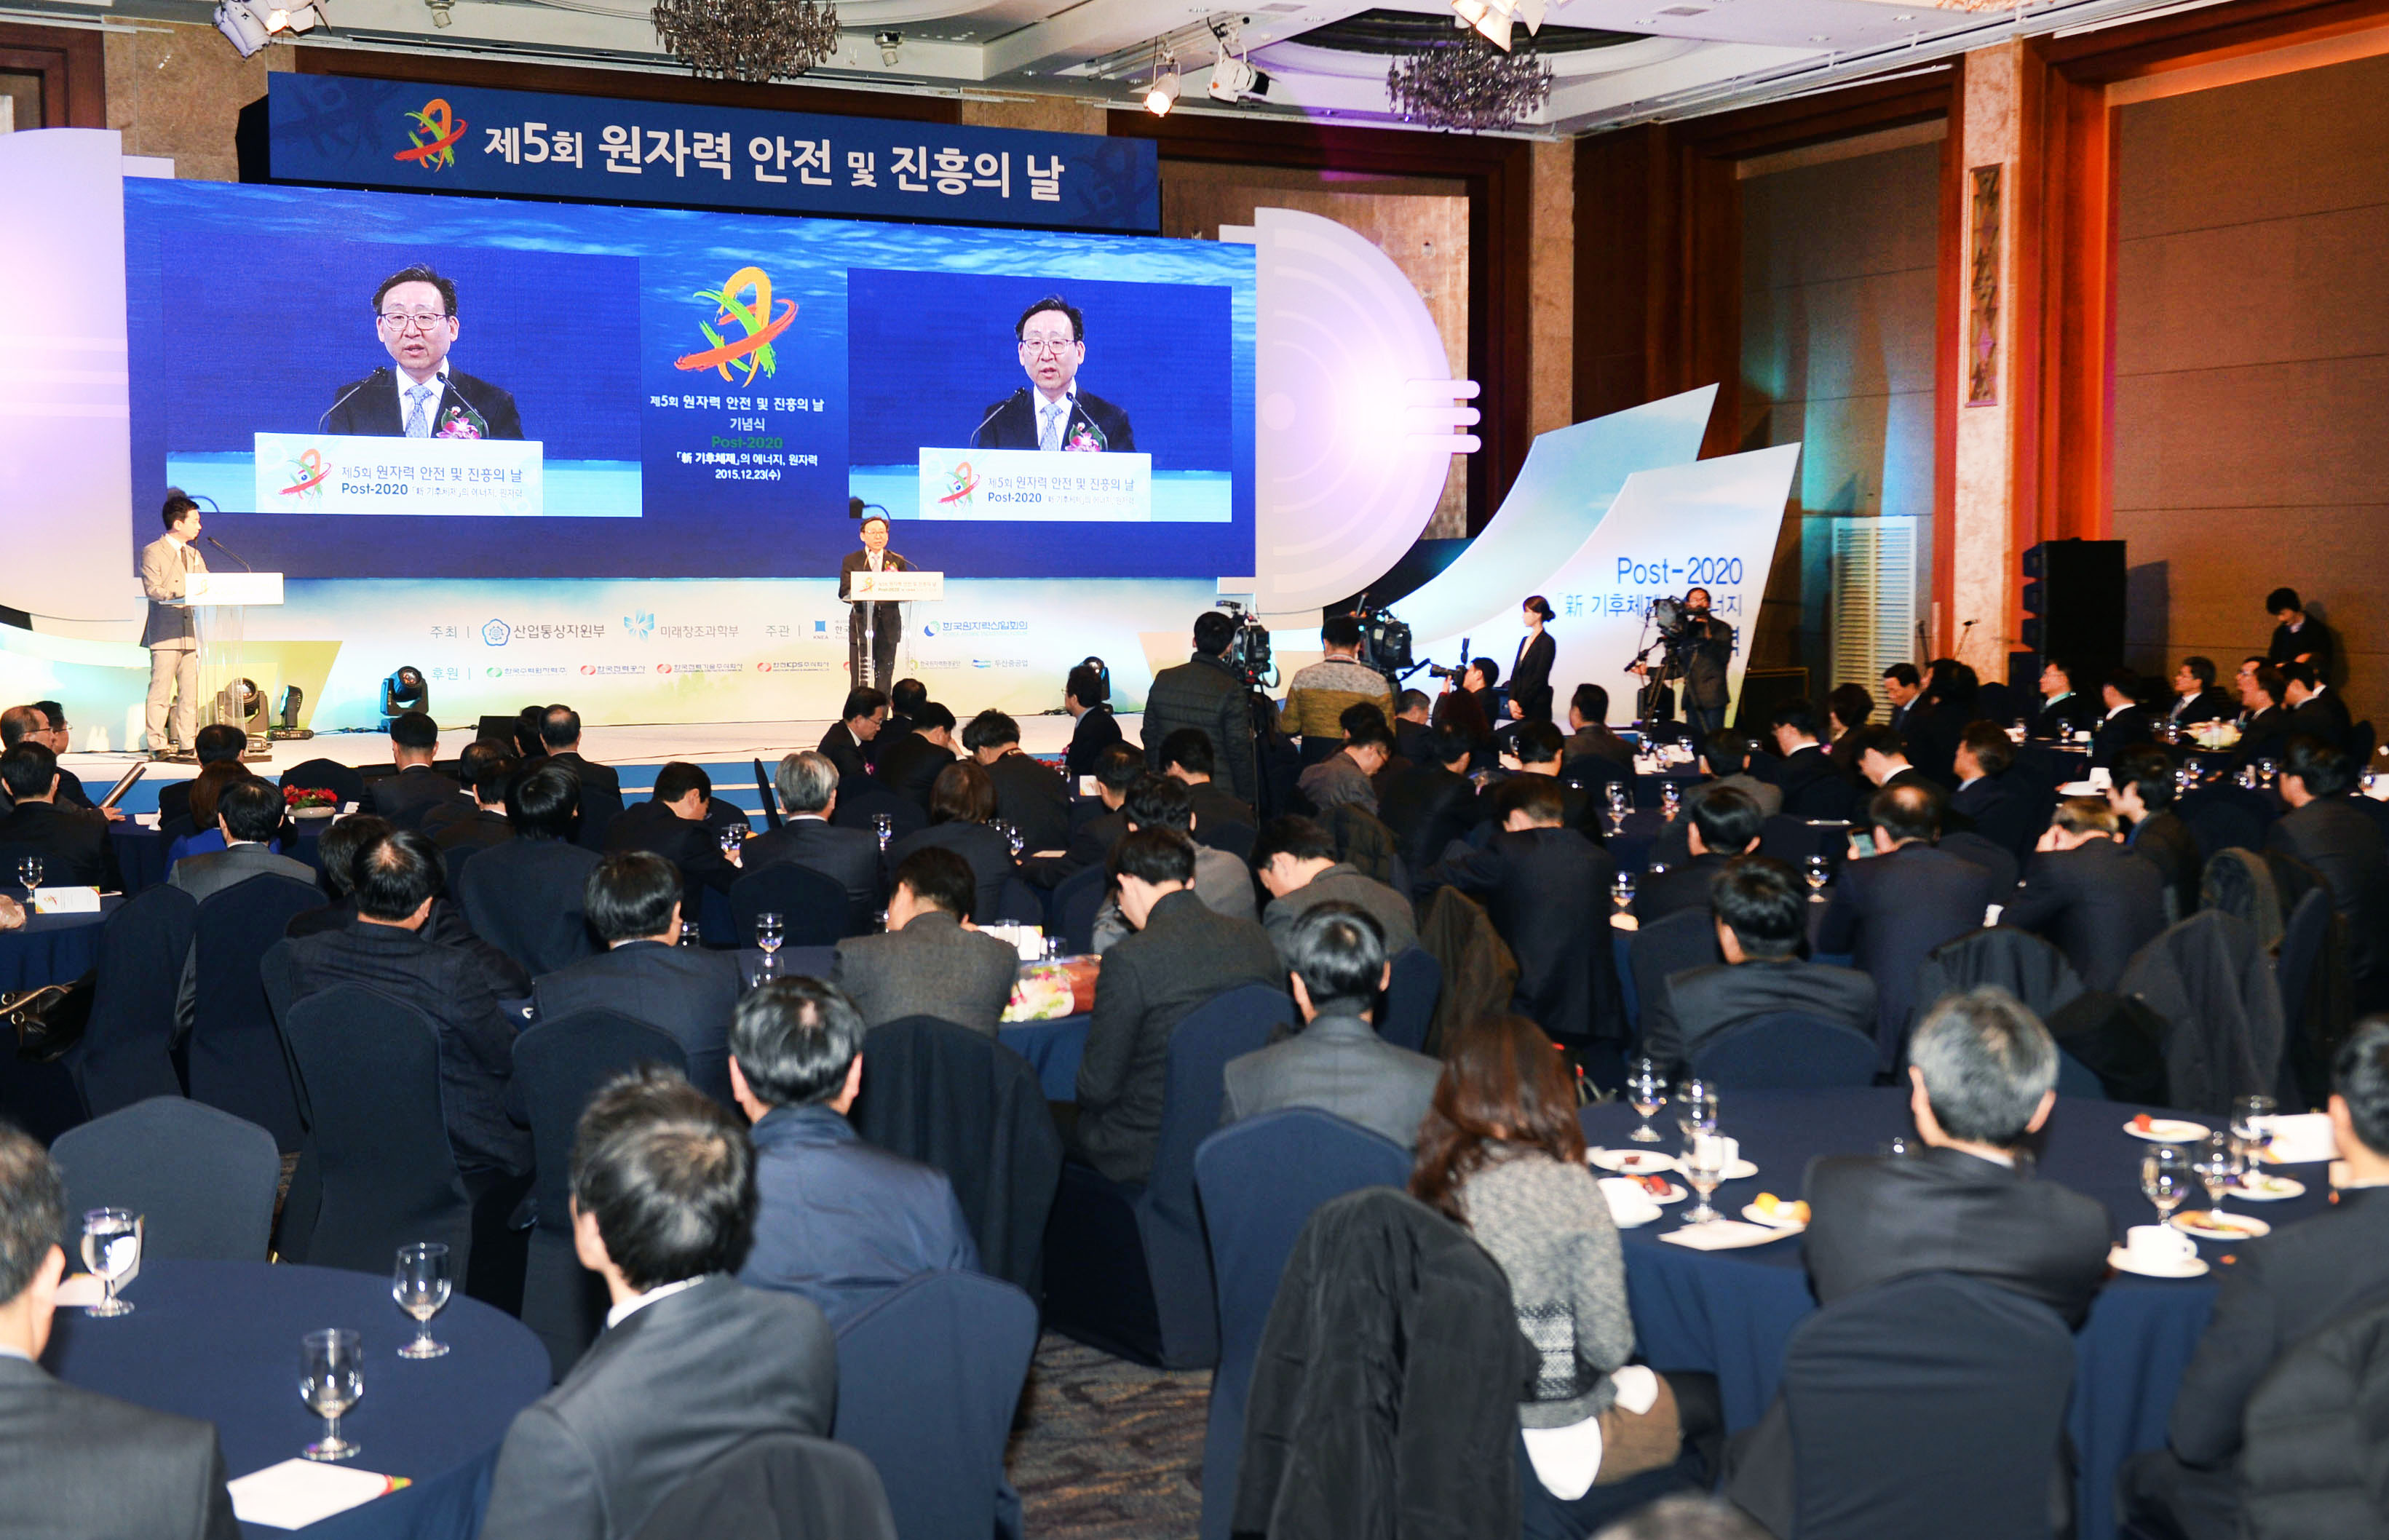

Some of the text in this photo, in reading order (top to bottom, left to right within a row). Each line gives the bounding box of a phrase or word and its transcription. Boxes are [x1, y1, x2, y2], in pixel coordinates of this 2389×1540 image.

[484, 122, 1065, 202] 제5회 원자력 안전 및 진흥의 날
[650, 396, 678, 408] 제5회
[683, 395, 721, 409] 원자력
[726, 397, 751, 410] 안전
[756, 397, 768, 410] 및
[812, 399, 825, 412] 날
[730, 418, 765, 432] 기념식
[711, 436, 783, 449] Post-2020
[788, 454, 818, 467] 원자력
[341, 466, 371, 480] 제5회
[376, 465, 414, 481] 원자력
[420, 467, 445, 482] 안전
[451, 467, 464, 482] 및
[510, 469, 523, 483] 날
[715, 469, 781, 480] 2015.12.23(수)
[341, 483, 408, 496] Post-2020
[988, 477, 1013, 489] 제5회
[1016, 477, 1047, 490] 원자력
[1051, 477, 1071, 491] 안전
[988, 492, 1042, 504] Post-2020
[1617, 557, 1743, 585] Post-2020
[430, 625, 458, 639] 주최
[513, 624, 606, 639] 산업통상자원부
[661, 624, 739, 638] 미래창조과학부
[766, 624, 790, 638] 주관
[432, 667, 459, 680] 후원
